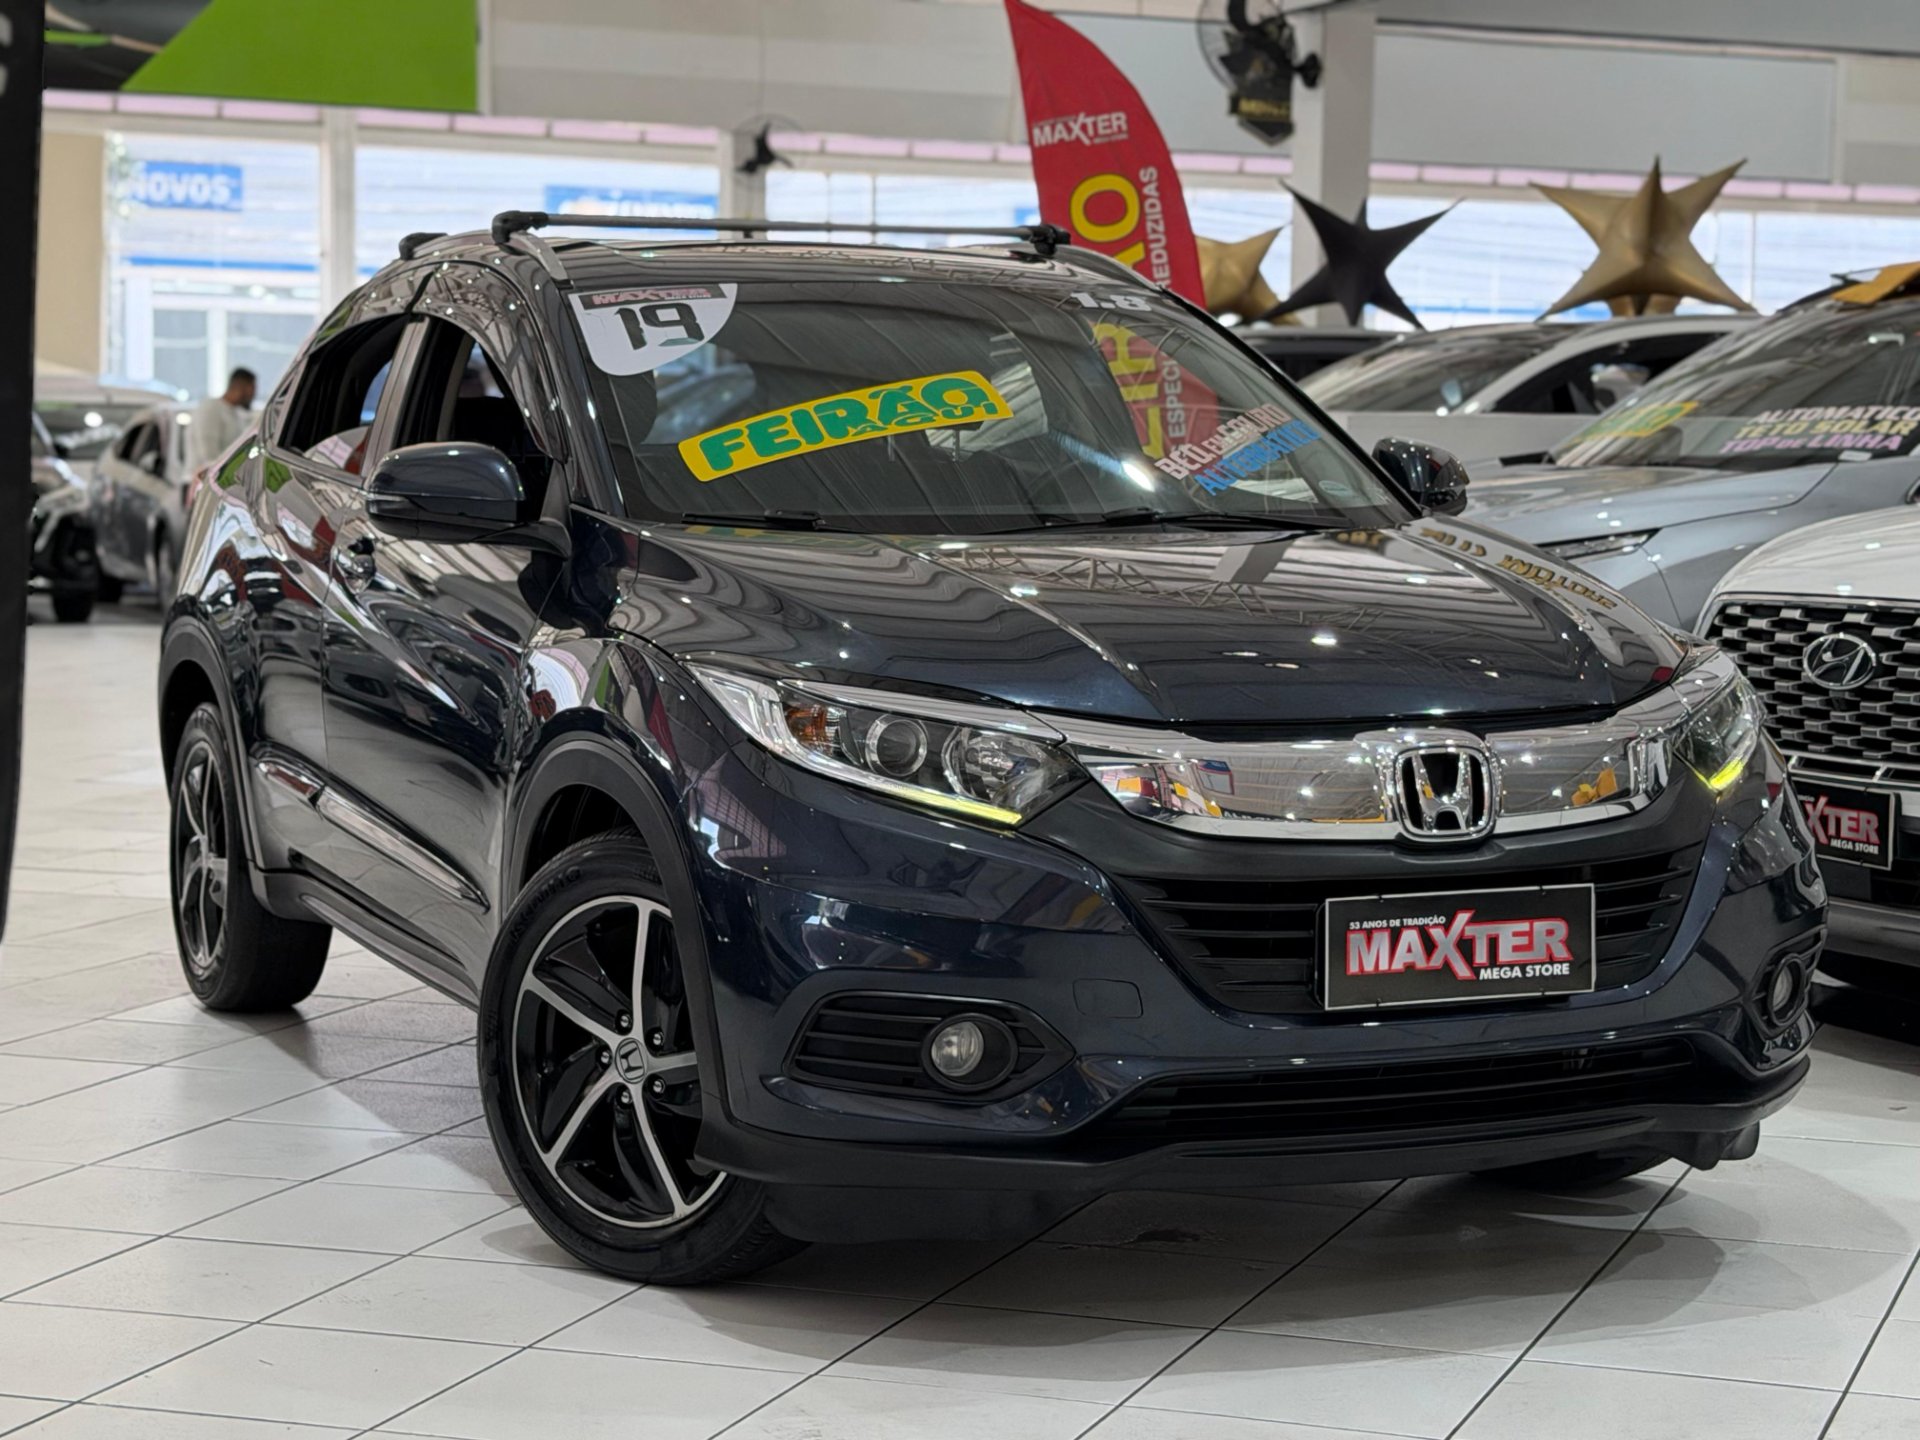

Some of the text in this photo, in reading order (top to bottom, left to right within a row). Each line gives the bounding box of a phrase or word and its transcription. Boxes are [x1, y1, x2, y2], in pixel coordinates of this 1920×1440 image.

[1032, 112, 1128, 147] MAXTER
[1070, 292, 1152, 311] 1.8
[614, 302, 705, 351] 19
[699, 377, 991, 472] FEIRÃO
[1734, 419, 1918, 439] TETO SOLAR
[1720, 436, 1780, 453] TOP
[1806, 433, 1904, 451] LINHA
[1830, 838, 1879, 855] MEGA STORE
[1361, 919, 1387, 930] ANOS
[1389, 918, 1401, 928] DE
[1402, 914, 1446, 928] TRADIÇÃO
[1346, 909, 1574, 980] MAXTER
[1479, 963, 1570, 980] MEGA STORE
